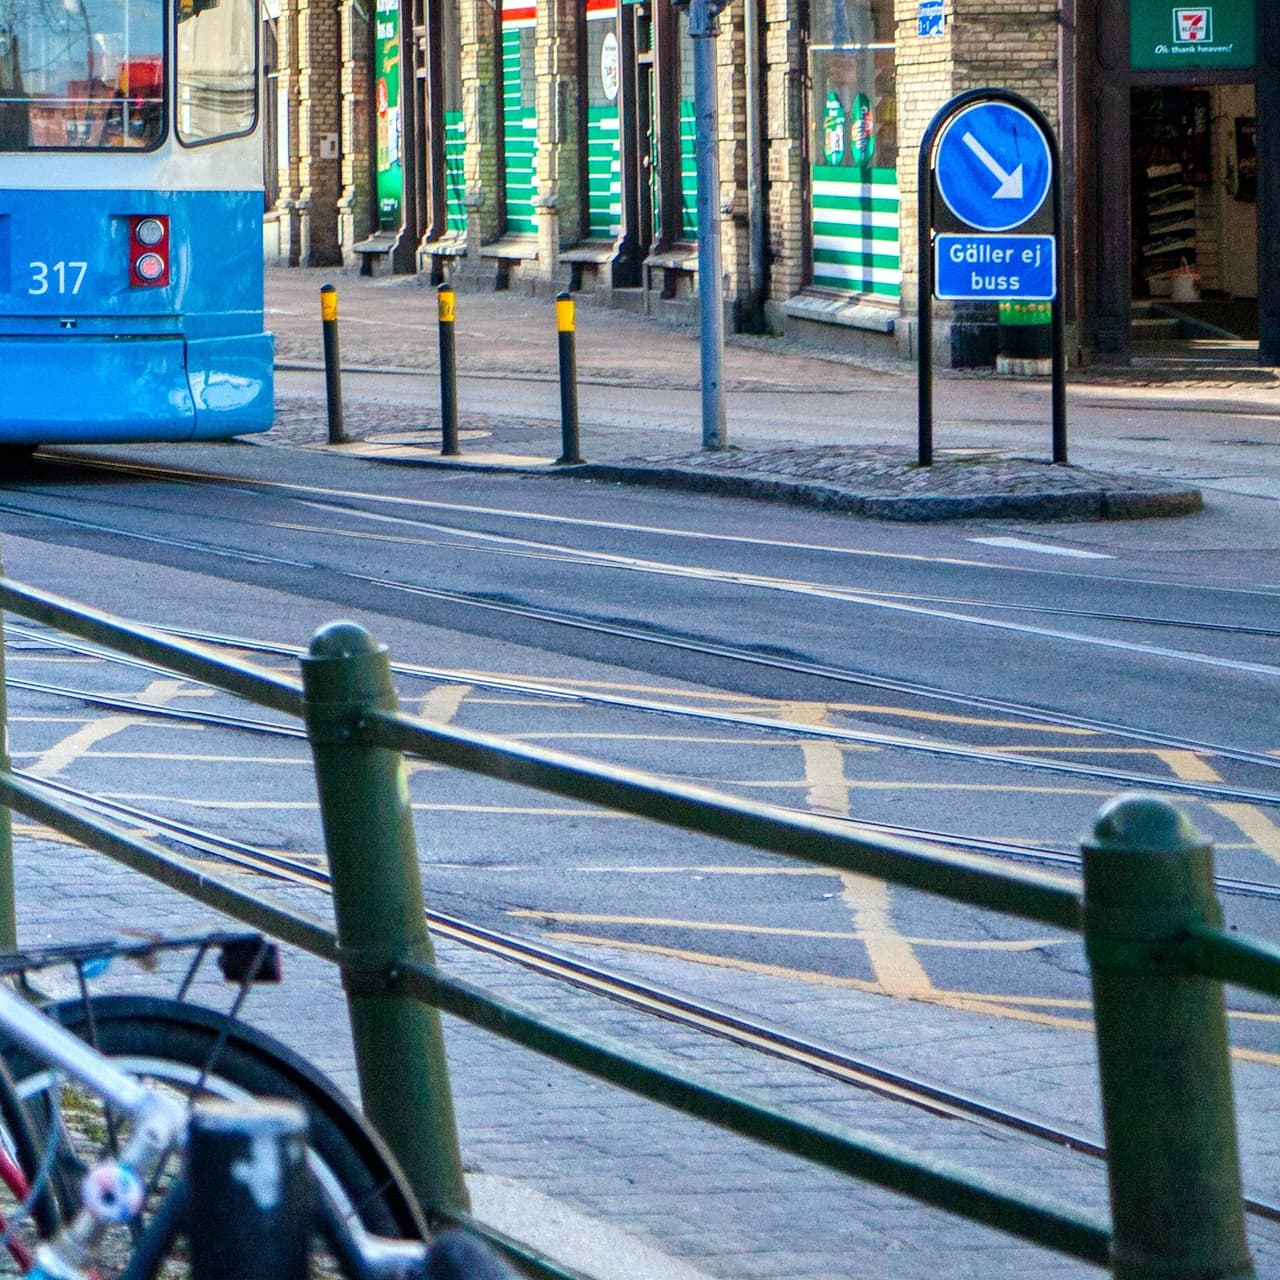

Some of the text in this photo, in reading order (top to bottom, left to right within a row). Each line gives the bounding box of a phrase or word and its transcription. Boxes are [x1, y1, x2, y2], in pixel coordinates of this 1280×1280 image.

[1172, 45, 1196, 54] thank
[950, 244, 1041, 268] Gäller ej
[28, 261, 88, 295] 317
[971, 271, 1020, 290] buss
